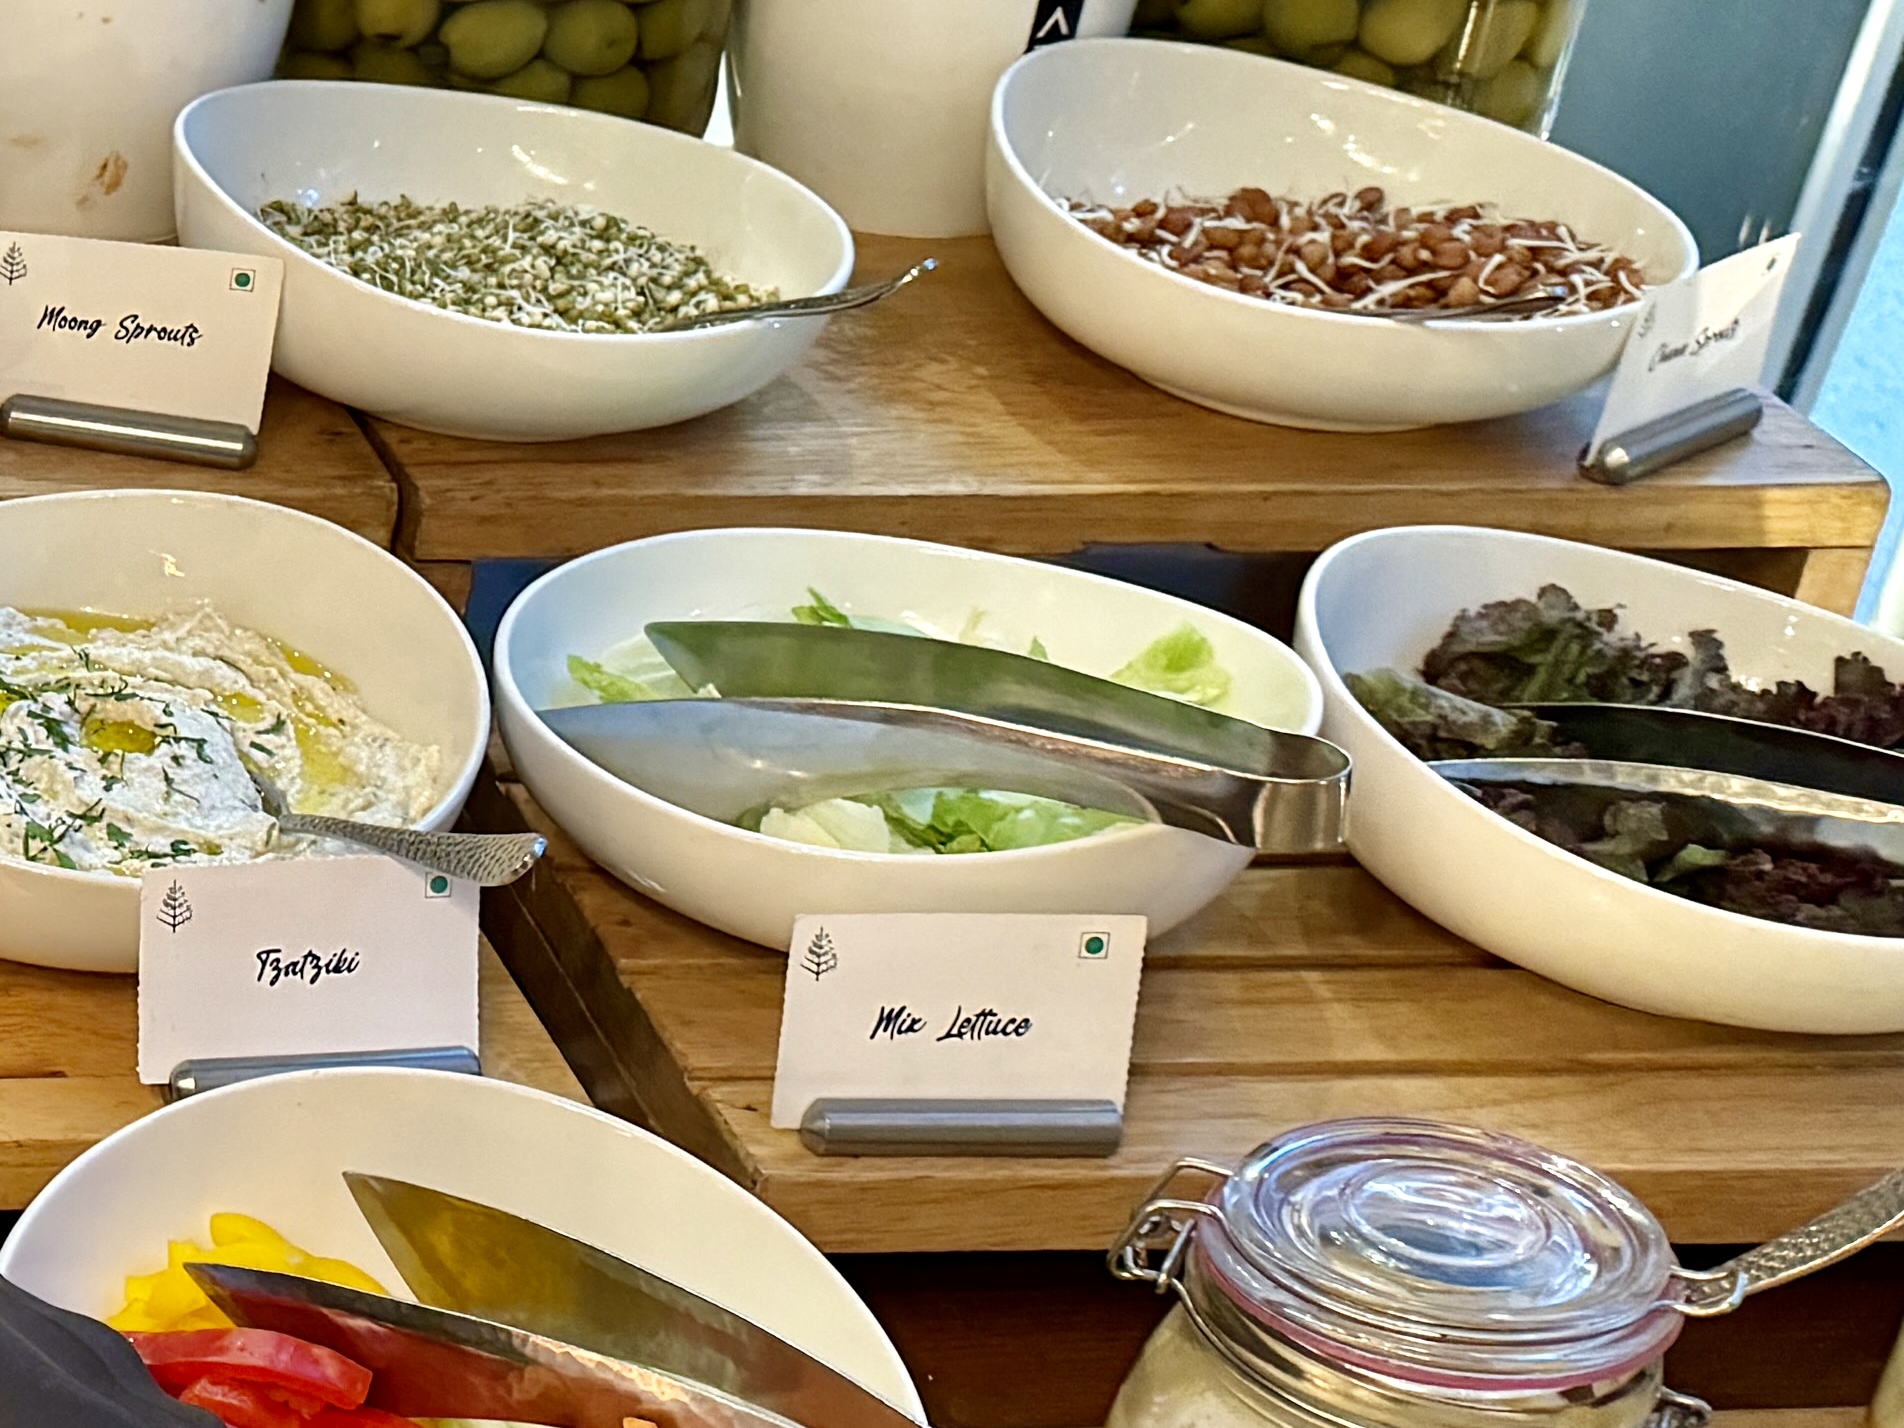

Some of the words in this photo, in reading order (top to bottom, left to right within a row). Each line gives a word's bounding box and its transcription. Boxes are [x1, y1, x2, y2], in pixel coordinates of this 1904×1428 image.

[36, 304, 107, 340] Moong
[113, 313, 204, 348] Sprouts
[255, 947, 361, 988] Tzatziki
[869, 1005, 928, 1041] Mix
[935, 1005, 1033, 1043] Lettuce
